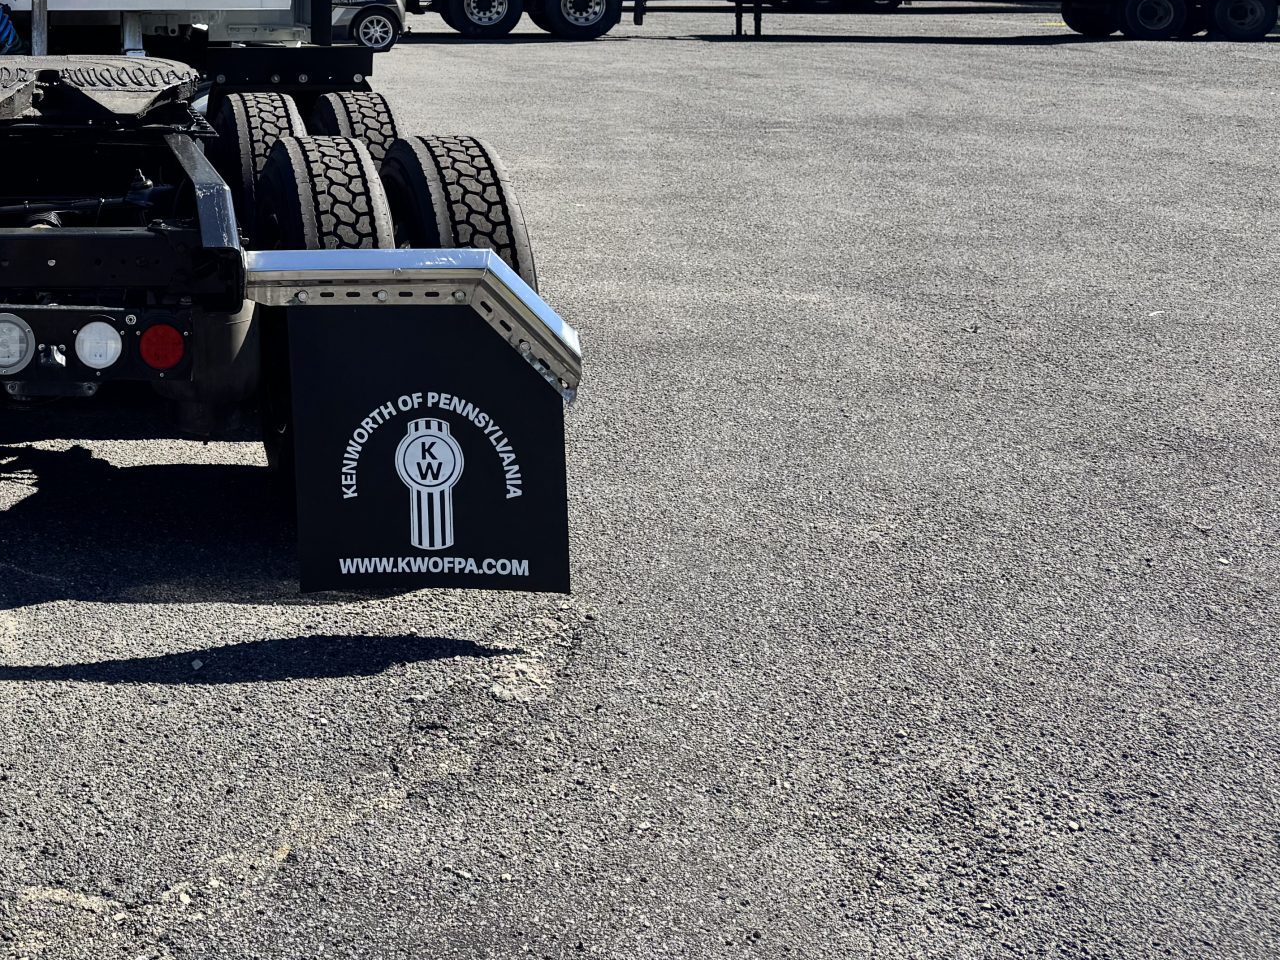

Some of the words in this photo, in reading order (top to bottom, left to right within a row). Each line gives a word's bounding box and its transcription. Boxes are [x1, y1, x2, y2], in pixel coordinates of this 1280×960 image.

[341, 401, 397, 499] KENWORTH
[397, 392, 423, 412] OF
[427, 391, 523, 499] PENNSYLVANIA
[339, 557, 530, 577] WWW.KWOFPA.COM
